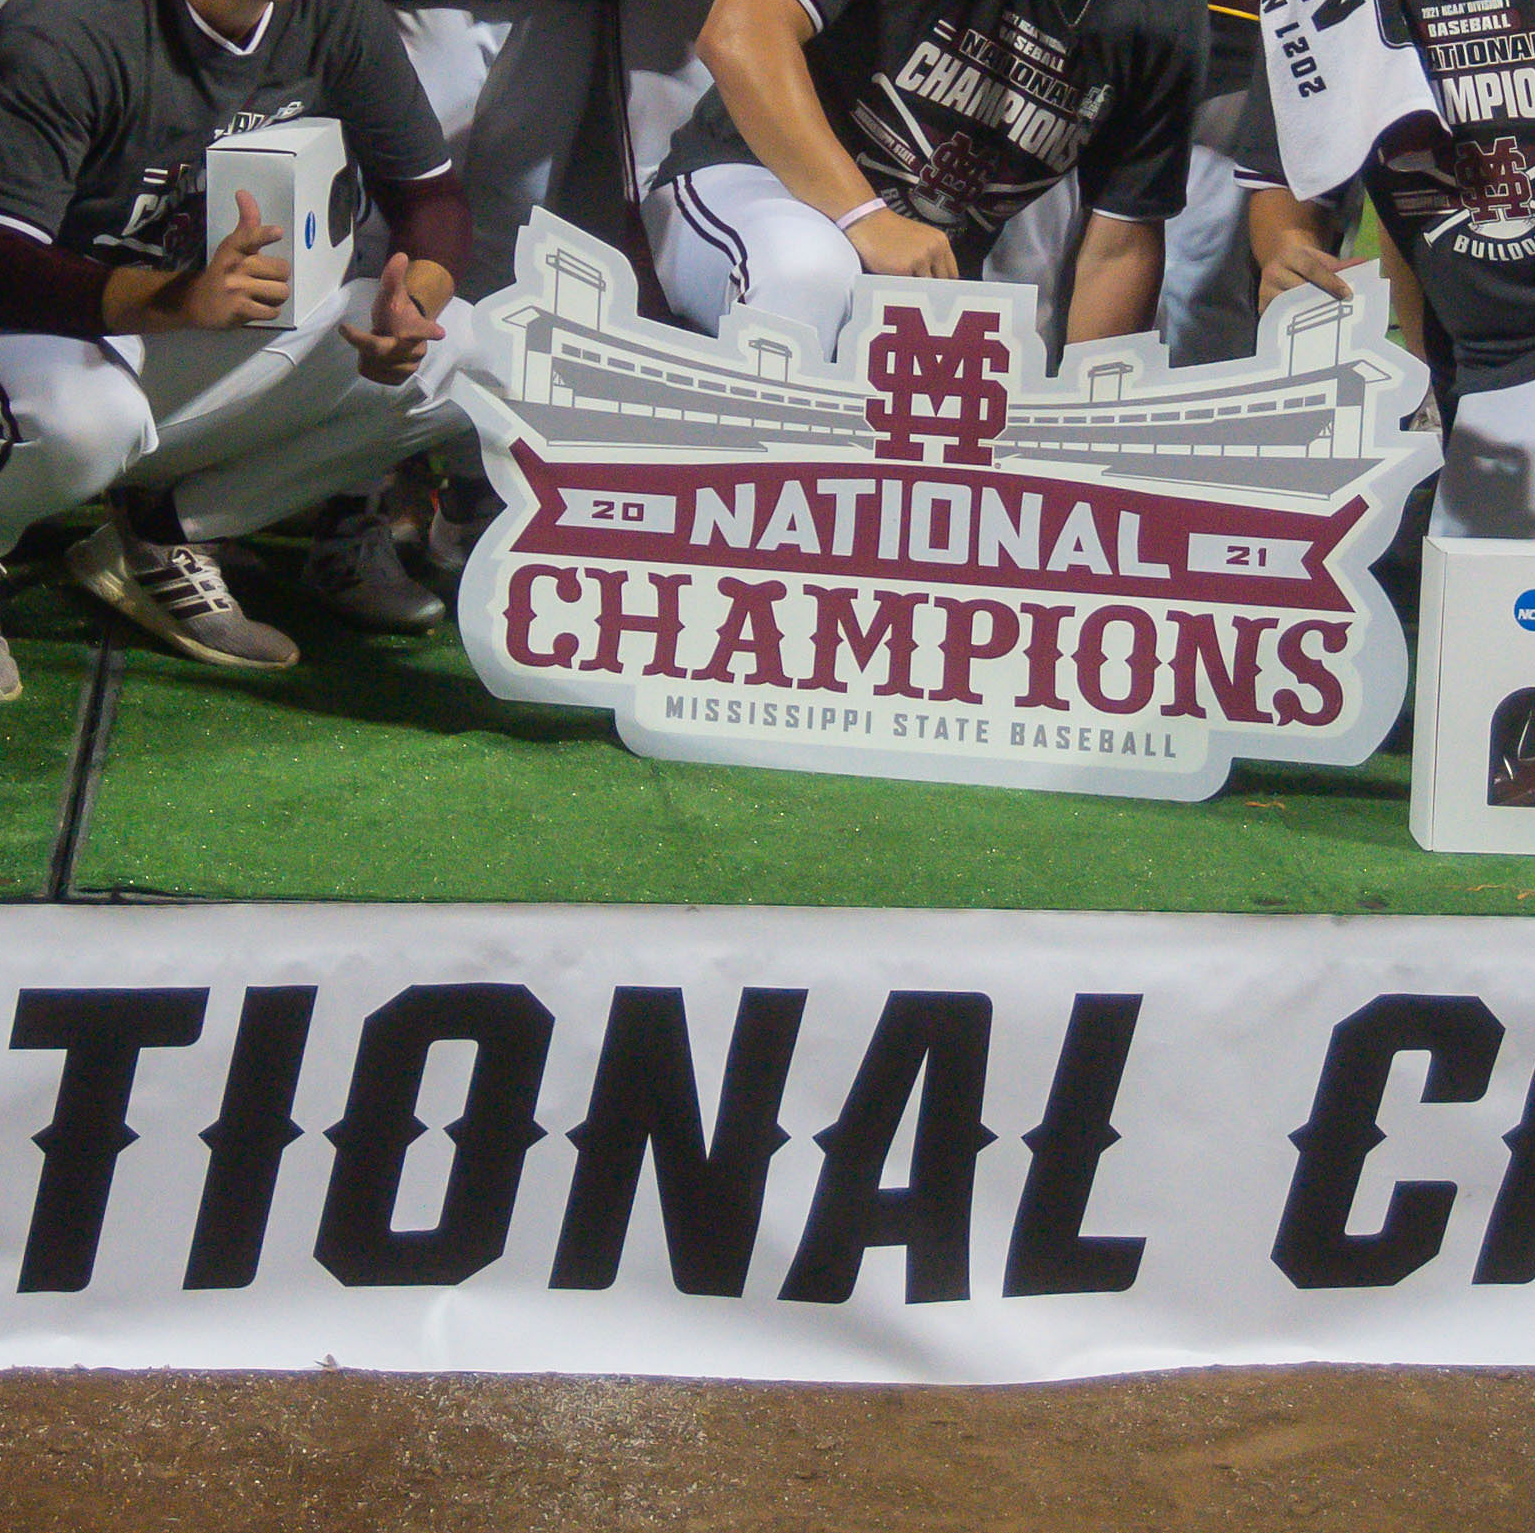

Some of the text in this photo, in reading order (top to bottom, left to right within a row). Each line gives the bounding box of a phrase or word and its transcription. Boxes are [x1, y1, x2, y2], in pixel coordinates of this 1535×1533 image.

[1274, 21, 1327, 98] 2021
[1428, 14, 1511, 37] BASEBALL
[895, 41, 1086, 172] CHAMPIONS
[590, 500, 645, 522] 20
[691, 476, 1170, 578] NATIONAL
[1225, 545, 1268, 565] 21
[503, 563, 1353, 726] CHAMPIONS
[665, 695, 1178, 759] MISSISSIPPI STATE BASEBALL
